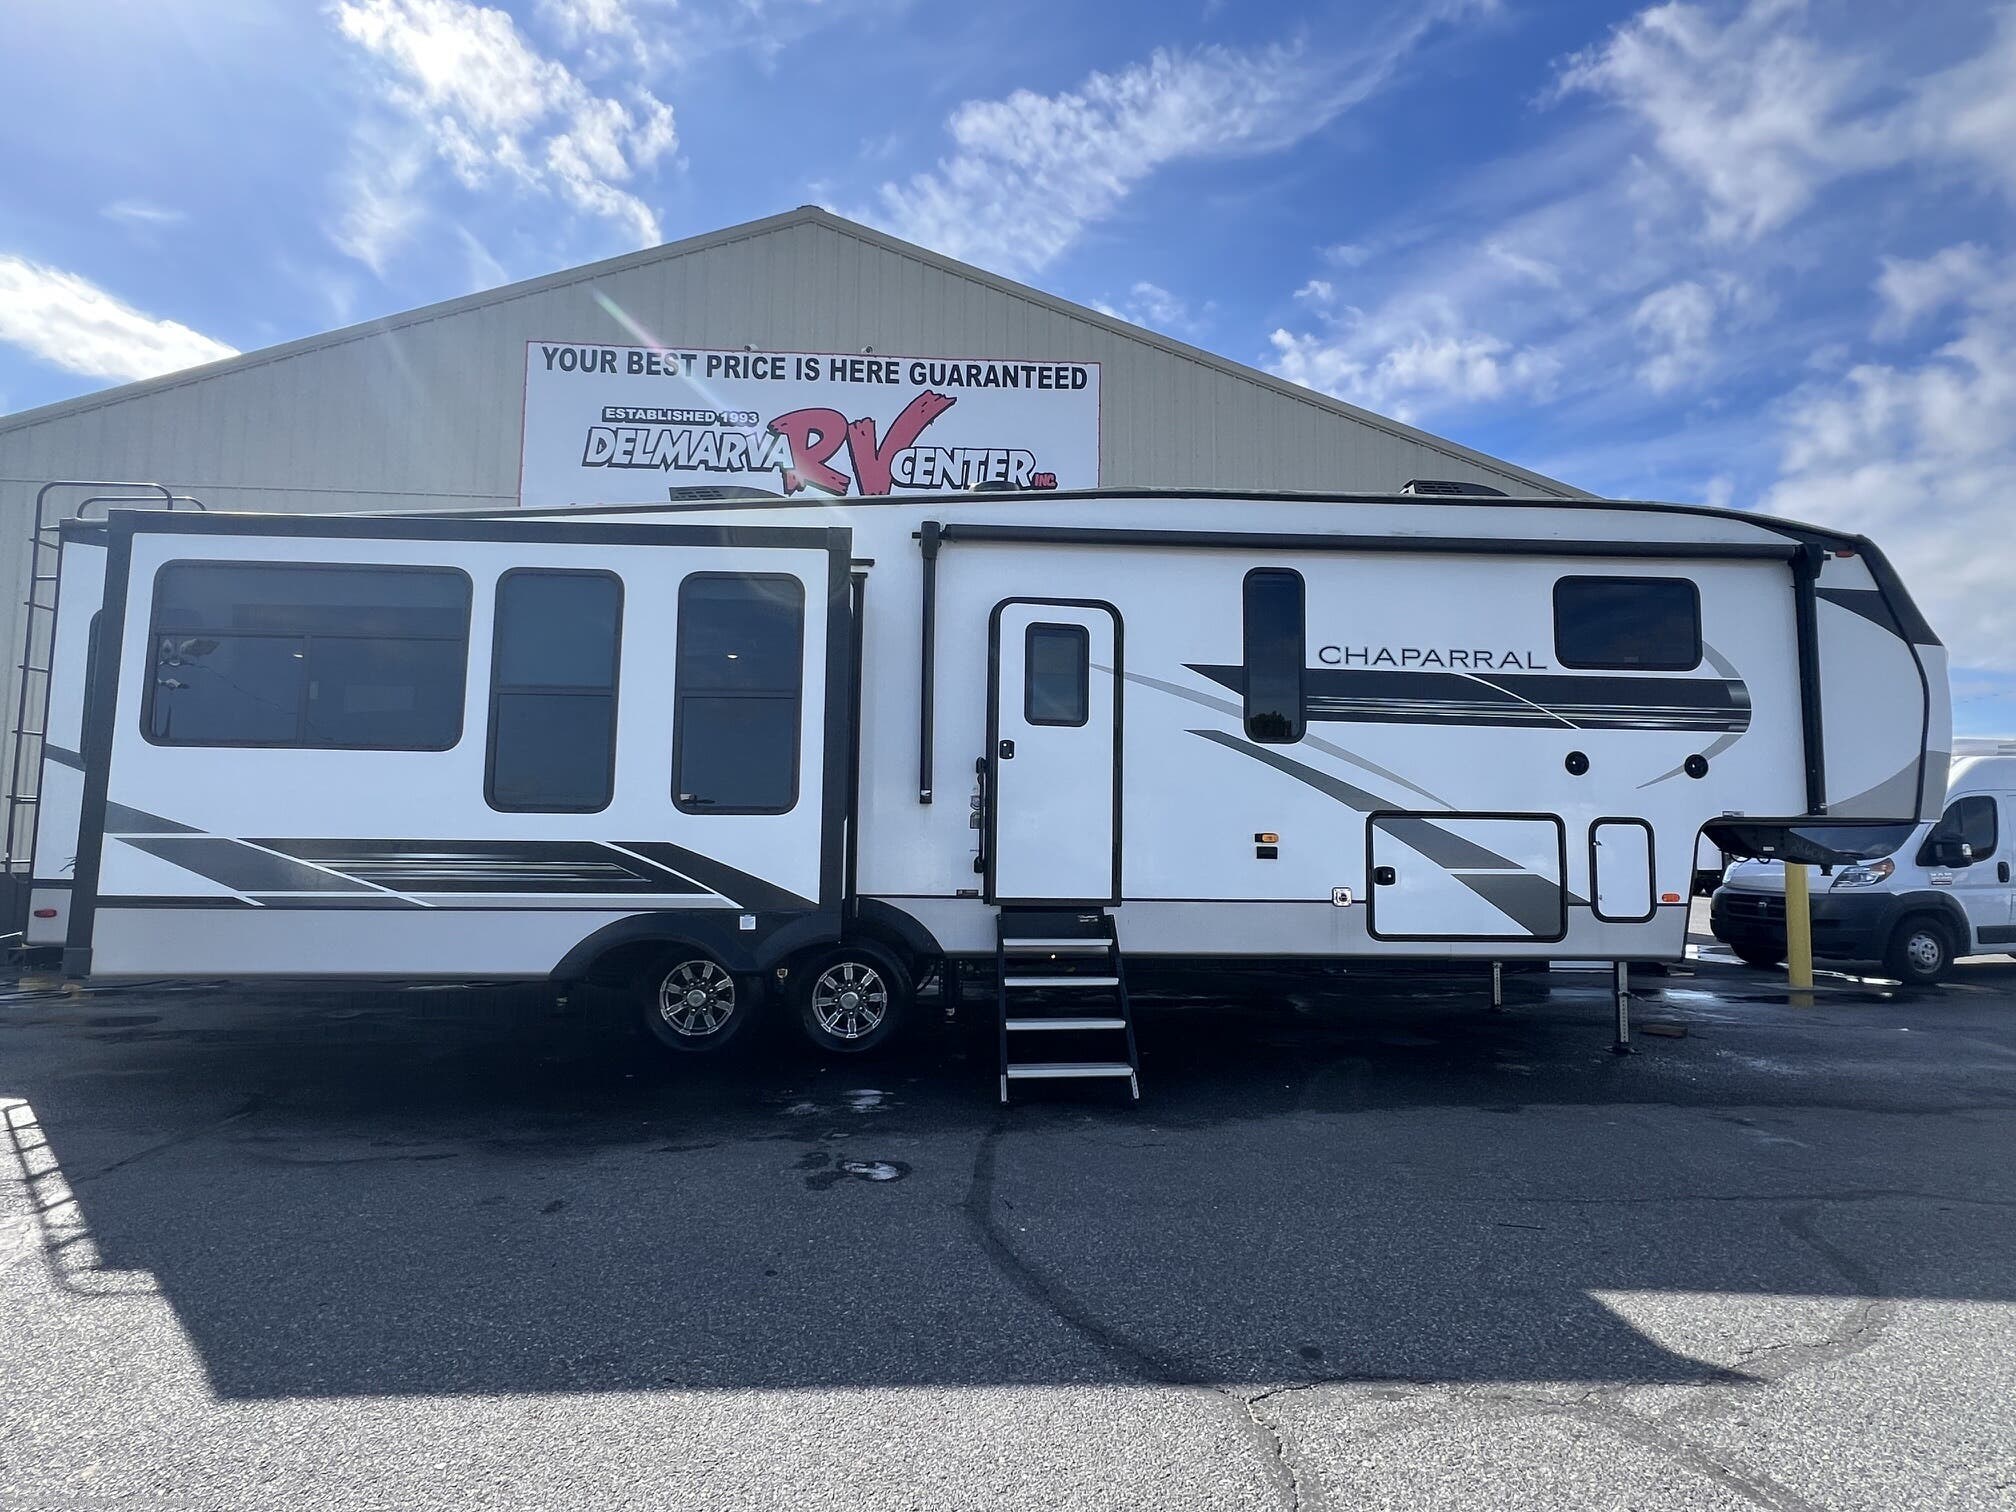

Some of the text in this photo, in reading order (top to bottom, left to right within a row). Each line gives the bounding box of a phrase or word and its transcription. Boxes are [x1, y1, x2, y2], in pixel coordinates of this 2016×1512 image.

[542, 346, 1088, 390] YOUR BEST PRICE IS HERE GUARANTEED
[604, 407, 758, 424] ESTABLISHED 1993
[582, 427, 794, 472] DELMARVA
[767, 390, 957, 496] RV
[890, 447, 1036, 489] CENTER
[1318, 645, 1548, 670] CHAPARRAL
